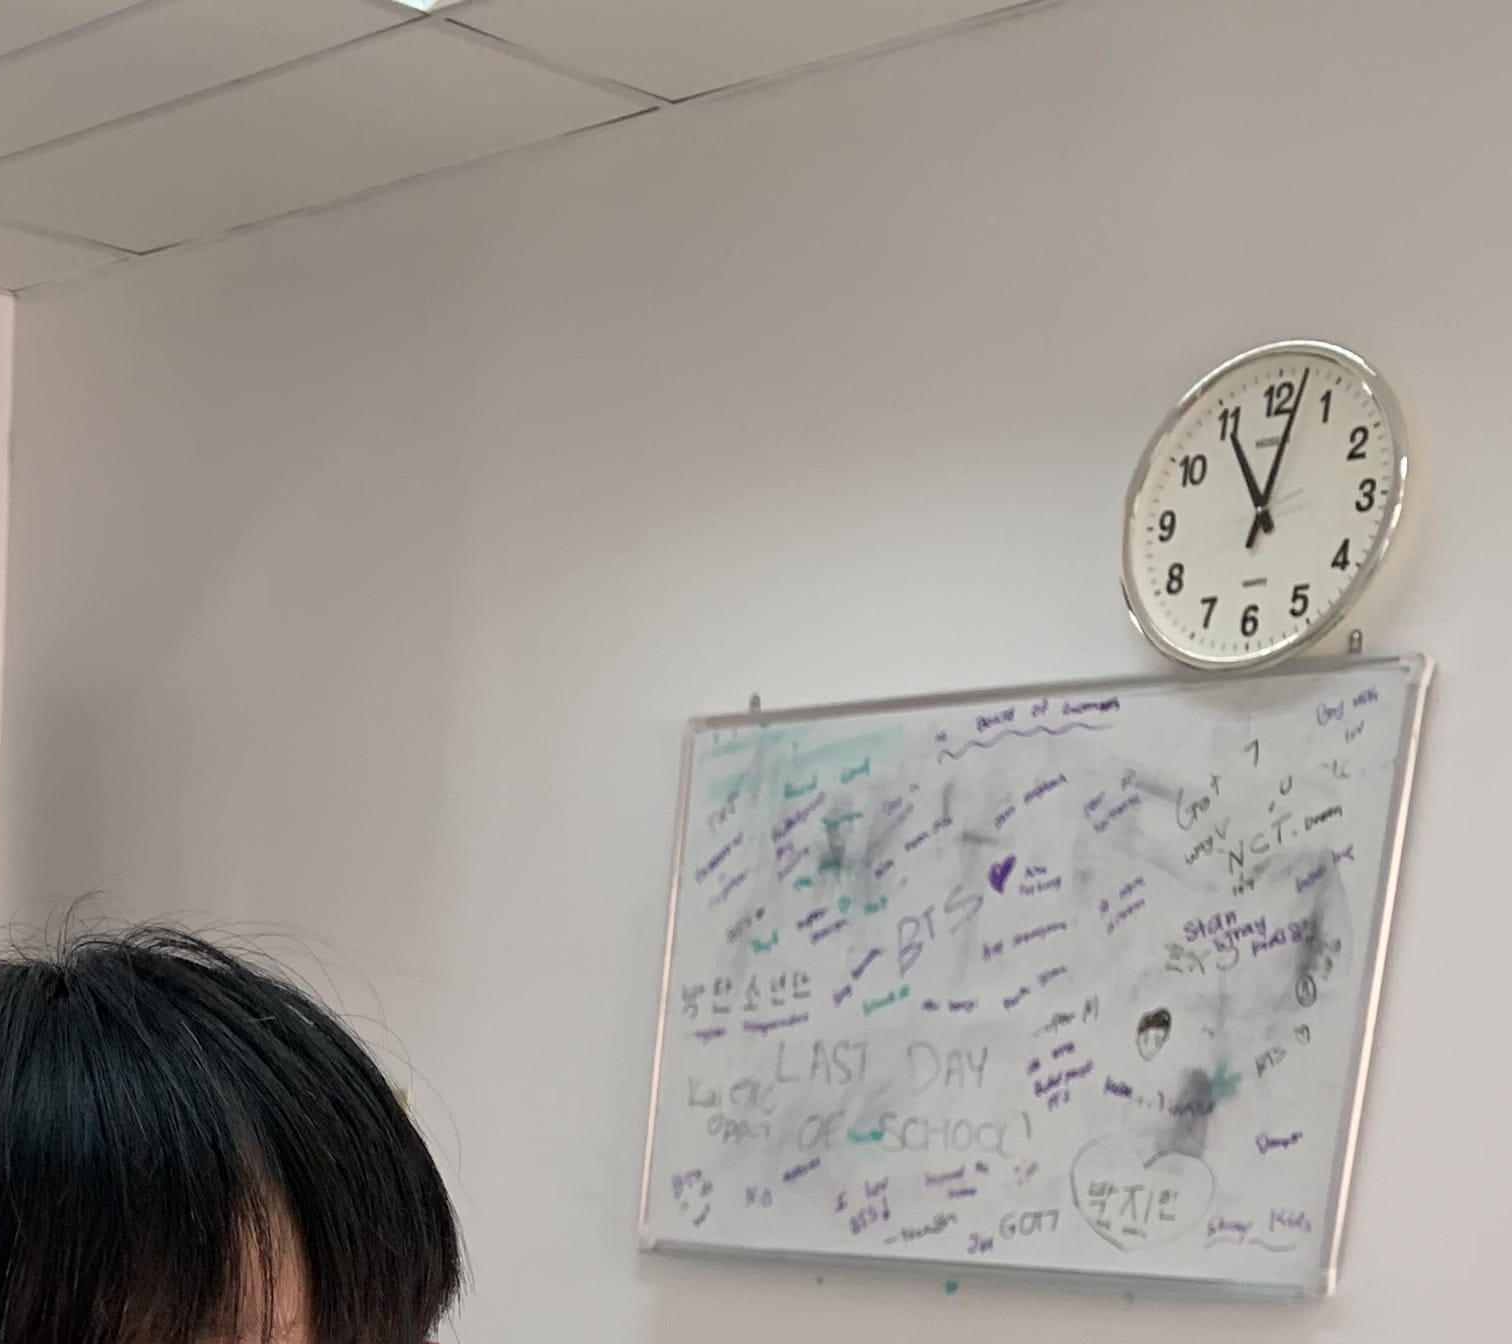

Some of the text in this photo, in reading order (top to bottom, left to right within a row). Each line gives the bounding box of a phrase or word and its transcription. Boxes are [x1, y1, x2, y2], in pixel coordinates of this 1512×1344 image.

[1264, 382, 1294, 417] 12
[1320, 390, 1332, 423] 1
[1218, 406, 1240, 441] 11
[1347, 426, 1369, 461] 2
[1179, 454, 1207, 487] 10
[1354, 478, 1377, 512] 3
[1159, 511, 1176, 542] 9
[1331, 539, 1350, 570] 4
[1166, 563, 1184, 595] 8
[1201, 597, 1218, 629] 7
[1290, 584, 1310, 617] 5
[1241, 605, 1259, 637] 6
[776, 1040, 988, 1096] LAST DAY
